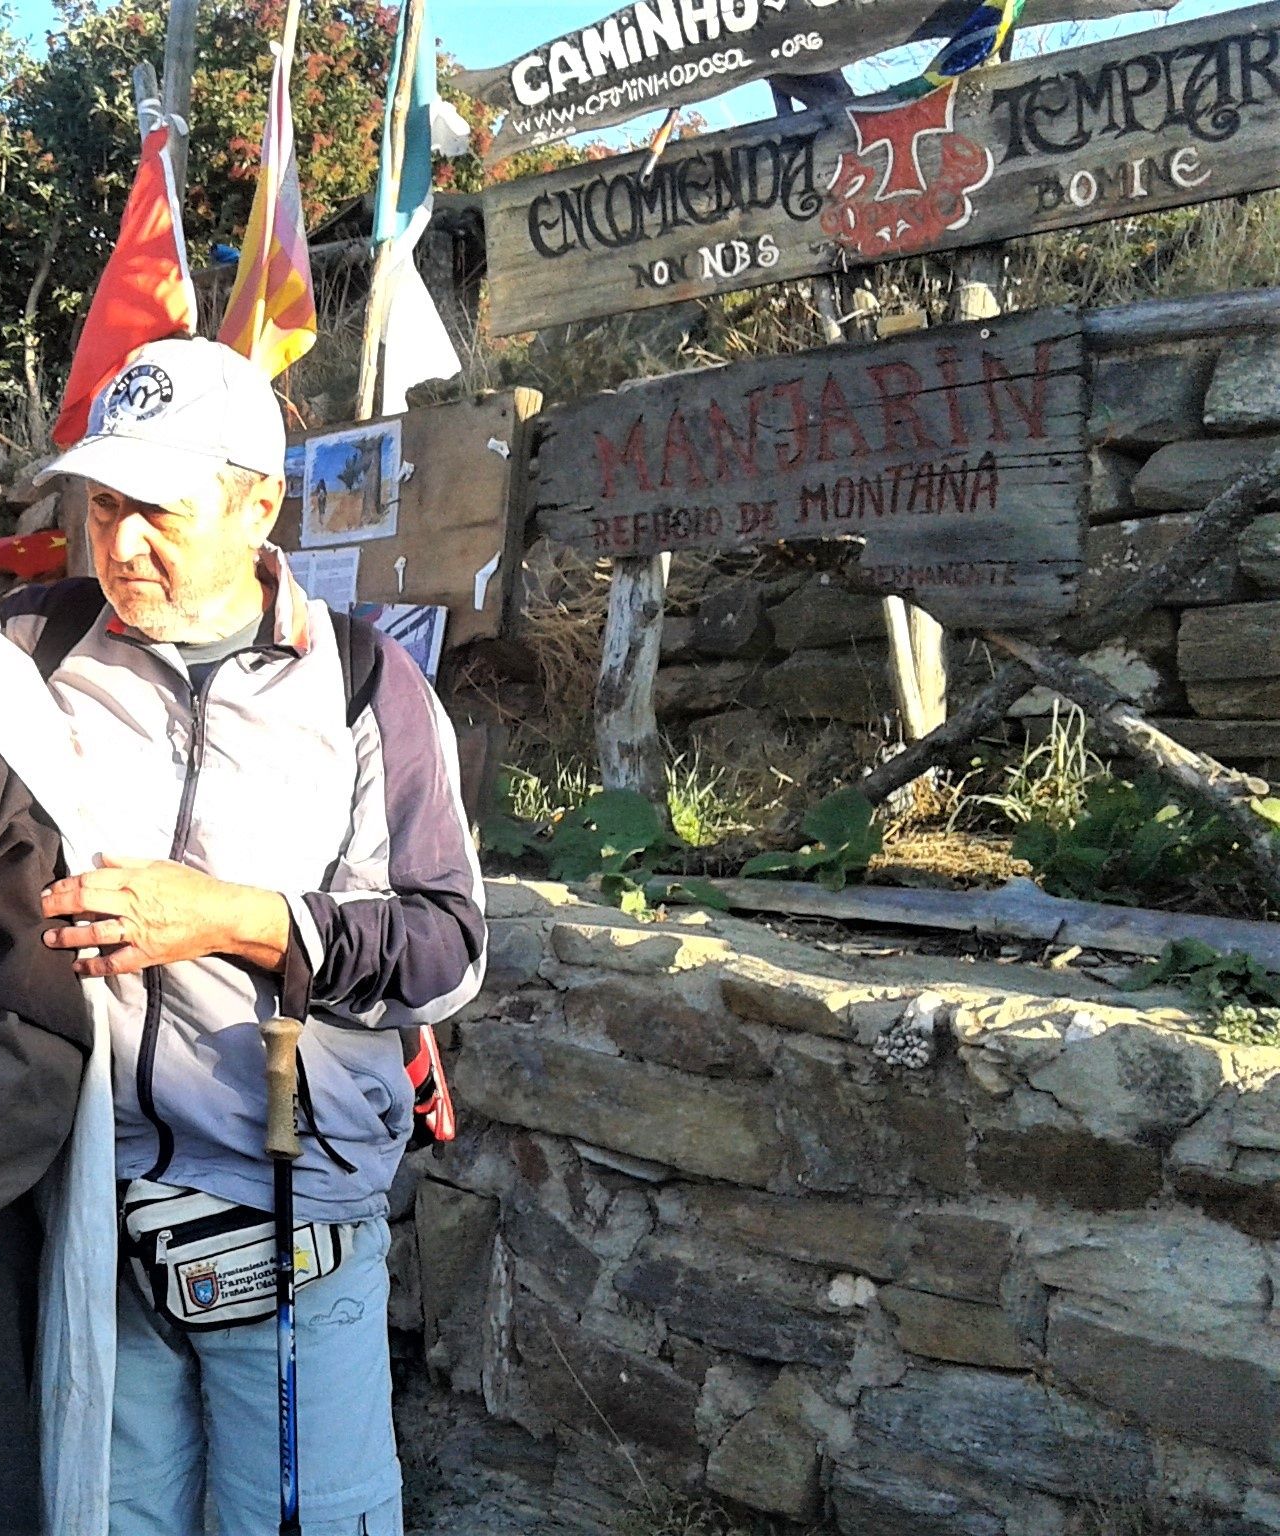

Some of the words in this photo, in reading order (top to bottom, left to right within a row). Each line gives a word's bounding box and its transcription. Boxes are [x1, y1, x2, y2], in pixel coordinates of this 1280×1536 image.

[528, 134, 823, 258] ENCOMIENDA
[736, 500, 776, 535] DE
[218, 1260, 269, 1279] Ayuntamiento
